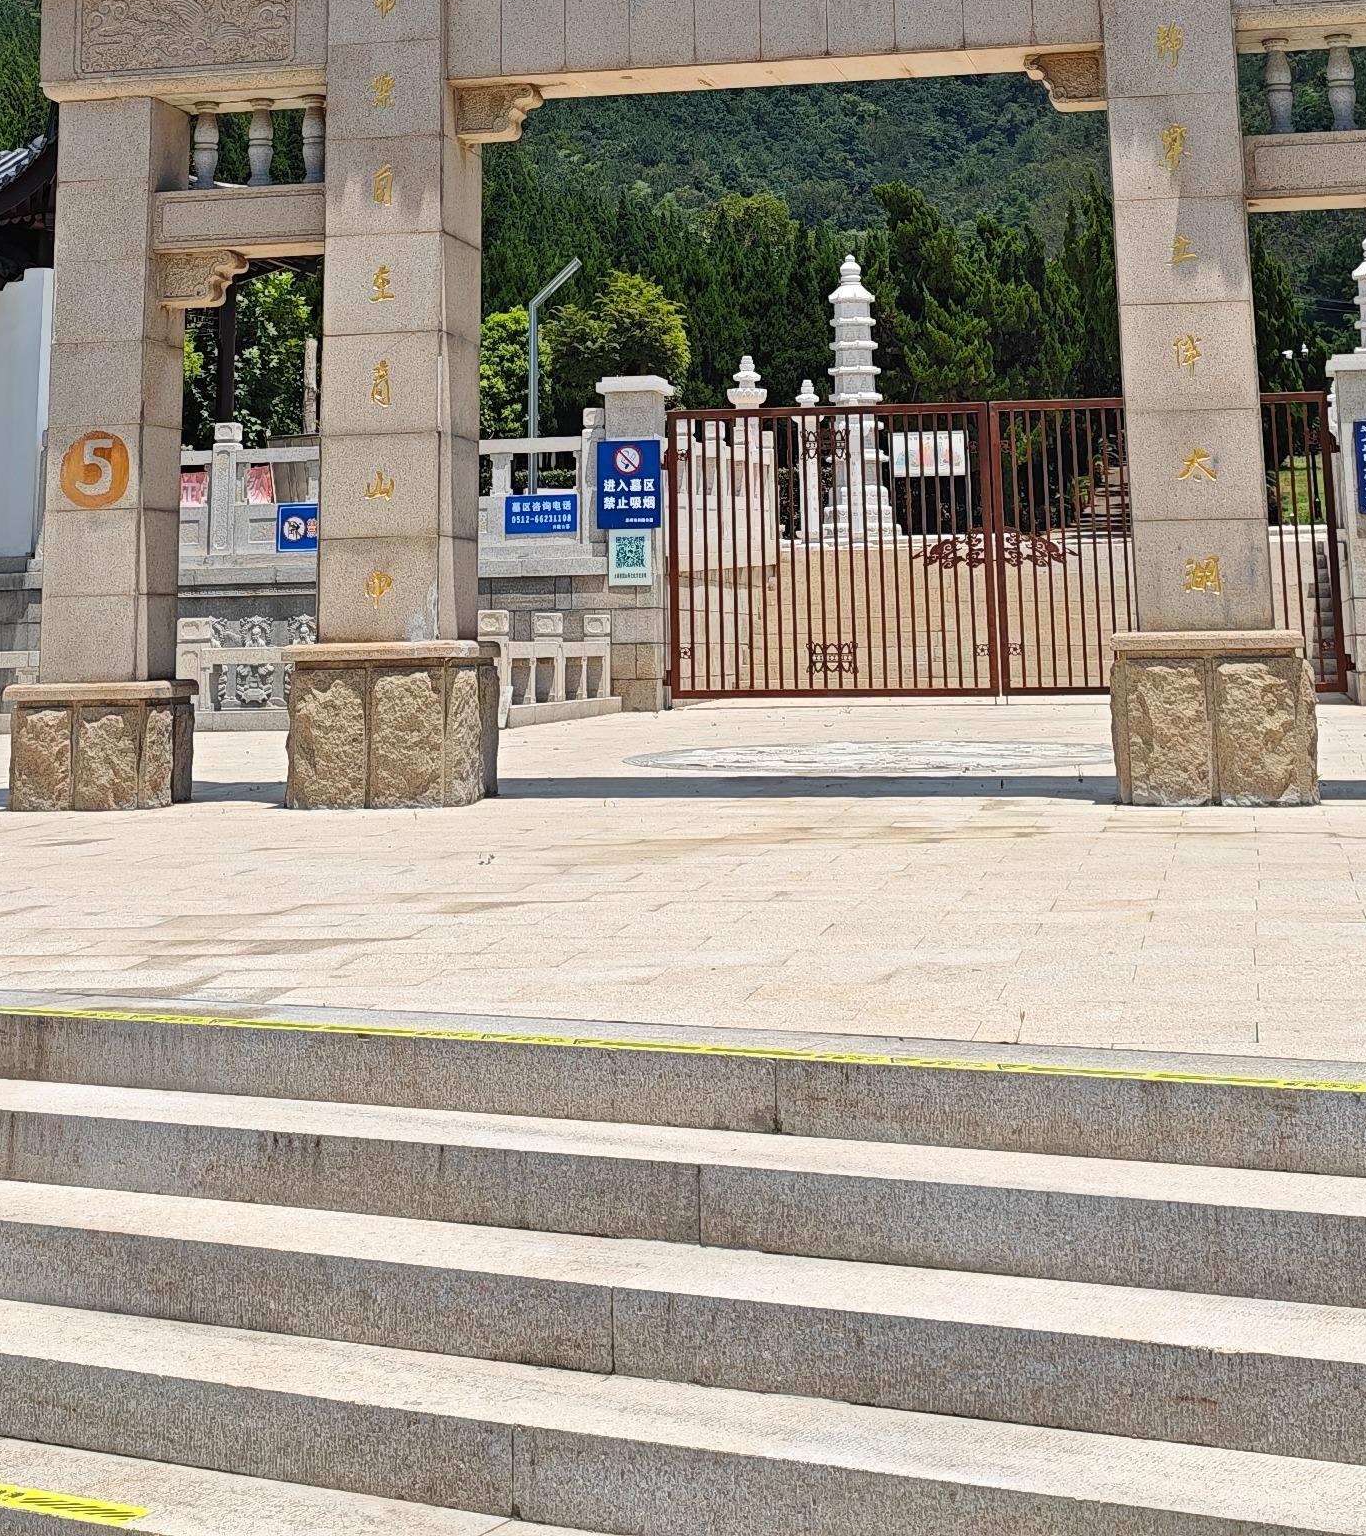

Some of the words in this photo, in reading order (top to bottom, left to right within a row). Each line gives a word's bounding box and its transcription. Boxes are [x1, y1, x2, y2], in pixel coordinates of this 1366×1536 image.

[75, 439, 113, 496] 5
[603, 479, 655, 492] 进入墓区
[512, 501, 572, 512] 墓区咨询电话
[603, 496, 655, 510] 禁止吸烟
[512, 514, 572, 524] 0512-66231108
